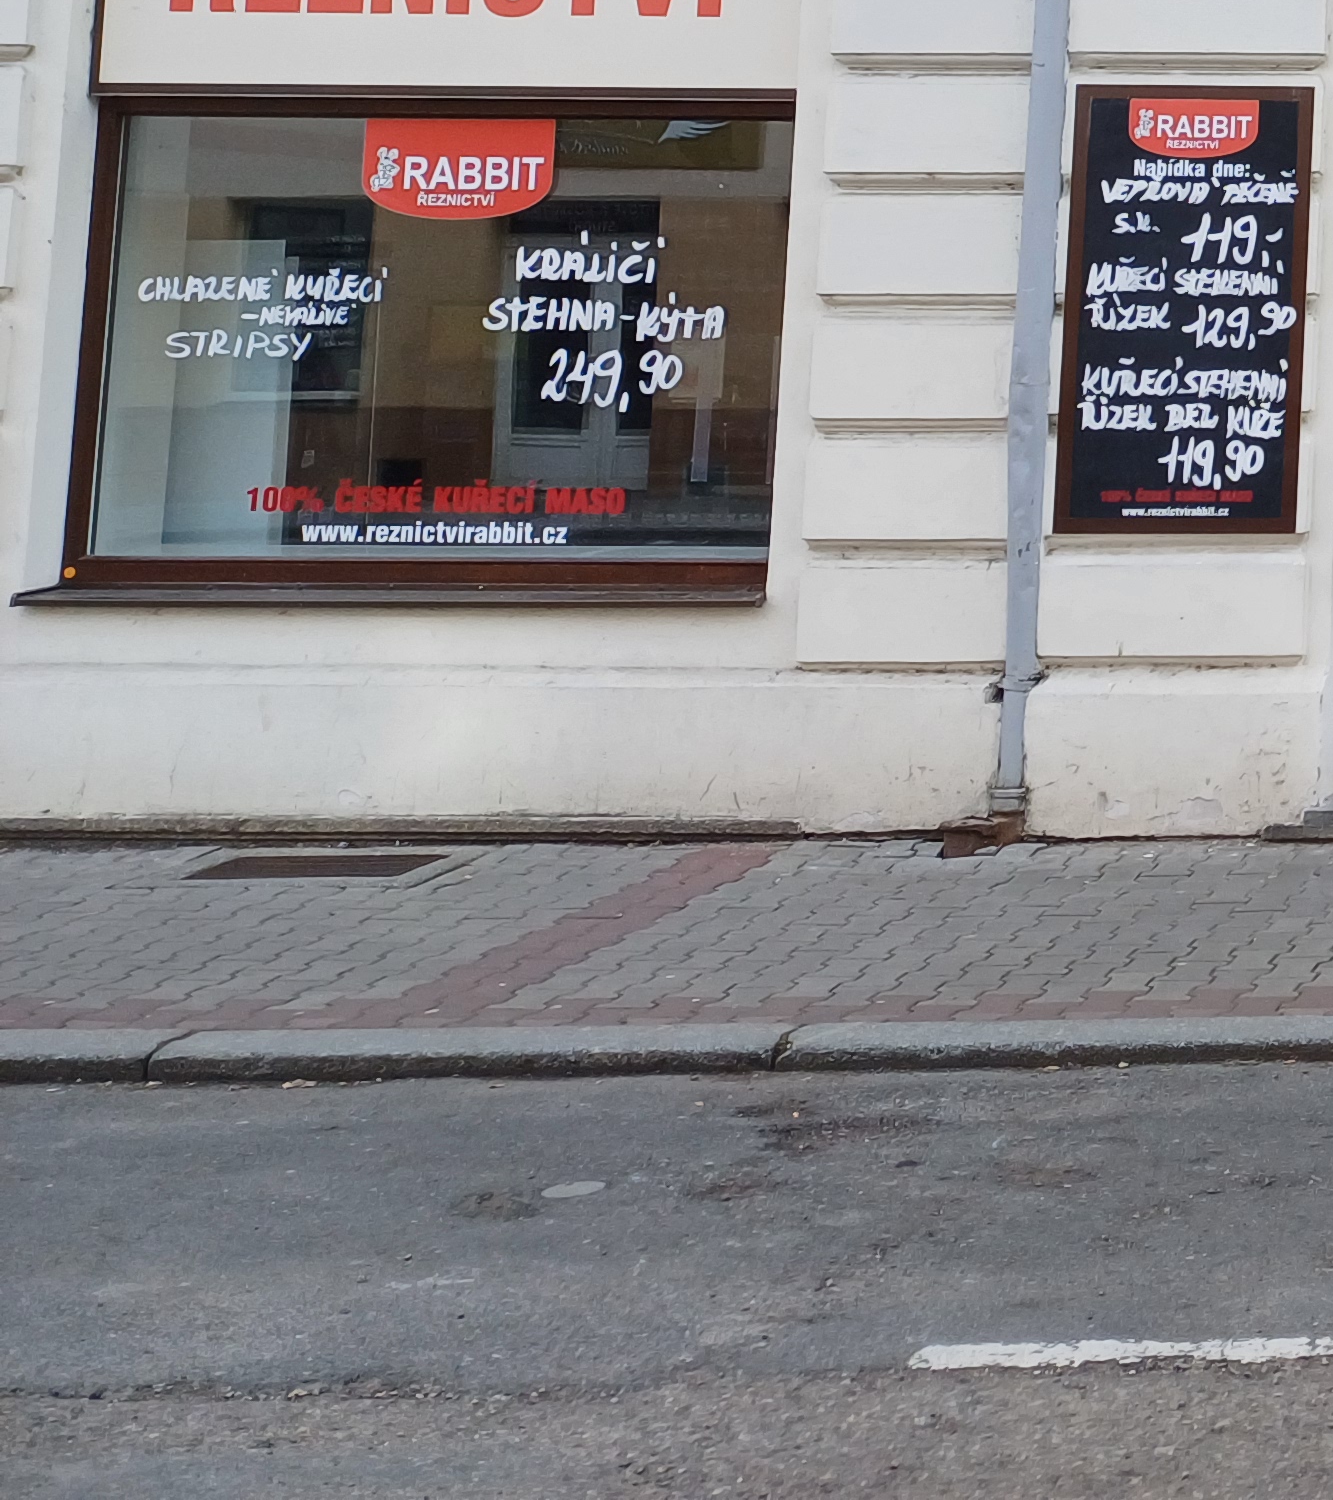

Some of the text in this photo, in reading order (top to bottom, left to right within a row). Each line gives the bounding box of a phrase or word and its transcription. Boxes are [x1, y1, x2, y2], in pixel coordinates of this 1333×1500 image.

[1156, 114, 1252, 139] RABBIT
[403, 156, 545, 191] RABBIT
[1134, 158, 1250, 177] Nabídka dne:
[417, 191, 496, 207] ŘEZNICTVÍ
[164, 329, 312, 361] STRIPSY
[247, 478, 626, 514] 100% ČESKÉ KUŘECÍ MASO
[302, 521, 568, 544] www.reznictvirabbit.cz
